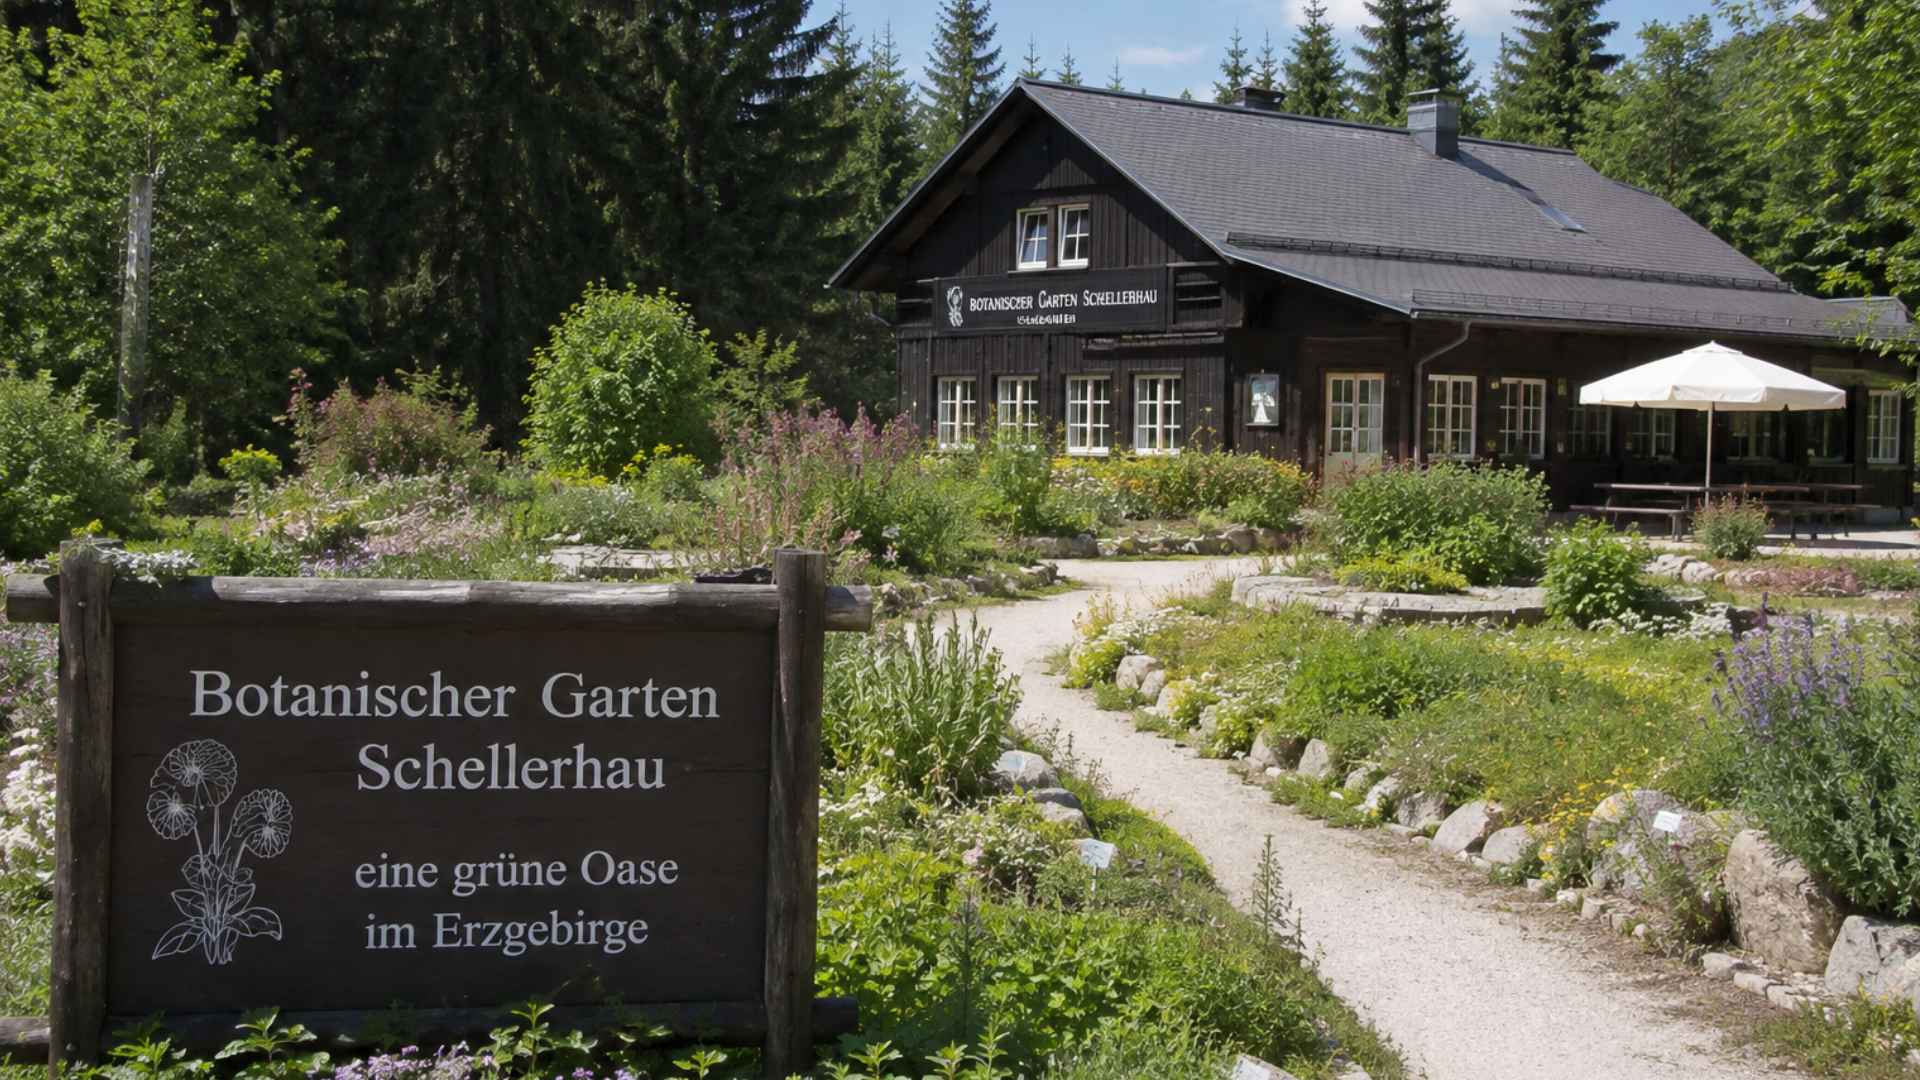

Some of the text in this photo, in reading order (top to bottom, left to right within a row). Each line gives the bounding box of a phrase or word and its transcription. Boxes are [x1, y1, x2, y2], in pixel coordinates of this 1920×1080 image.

[1038, 289, 1078, 309] GARTEN
[190, 669, 720, 719] Botanischer Garten
[357, 742, 666, 790] Schellerhau
[355, 850, 679, 897] eine grüne Oase
[365, 909, 649, 957] im Erzgebirge
